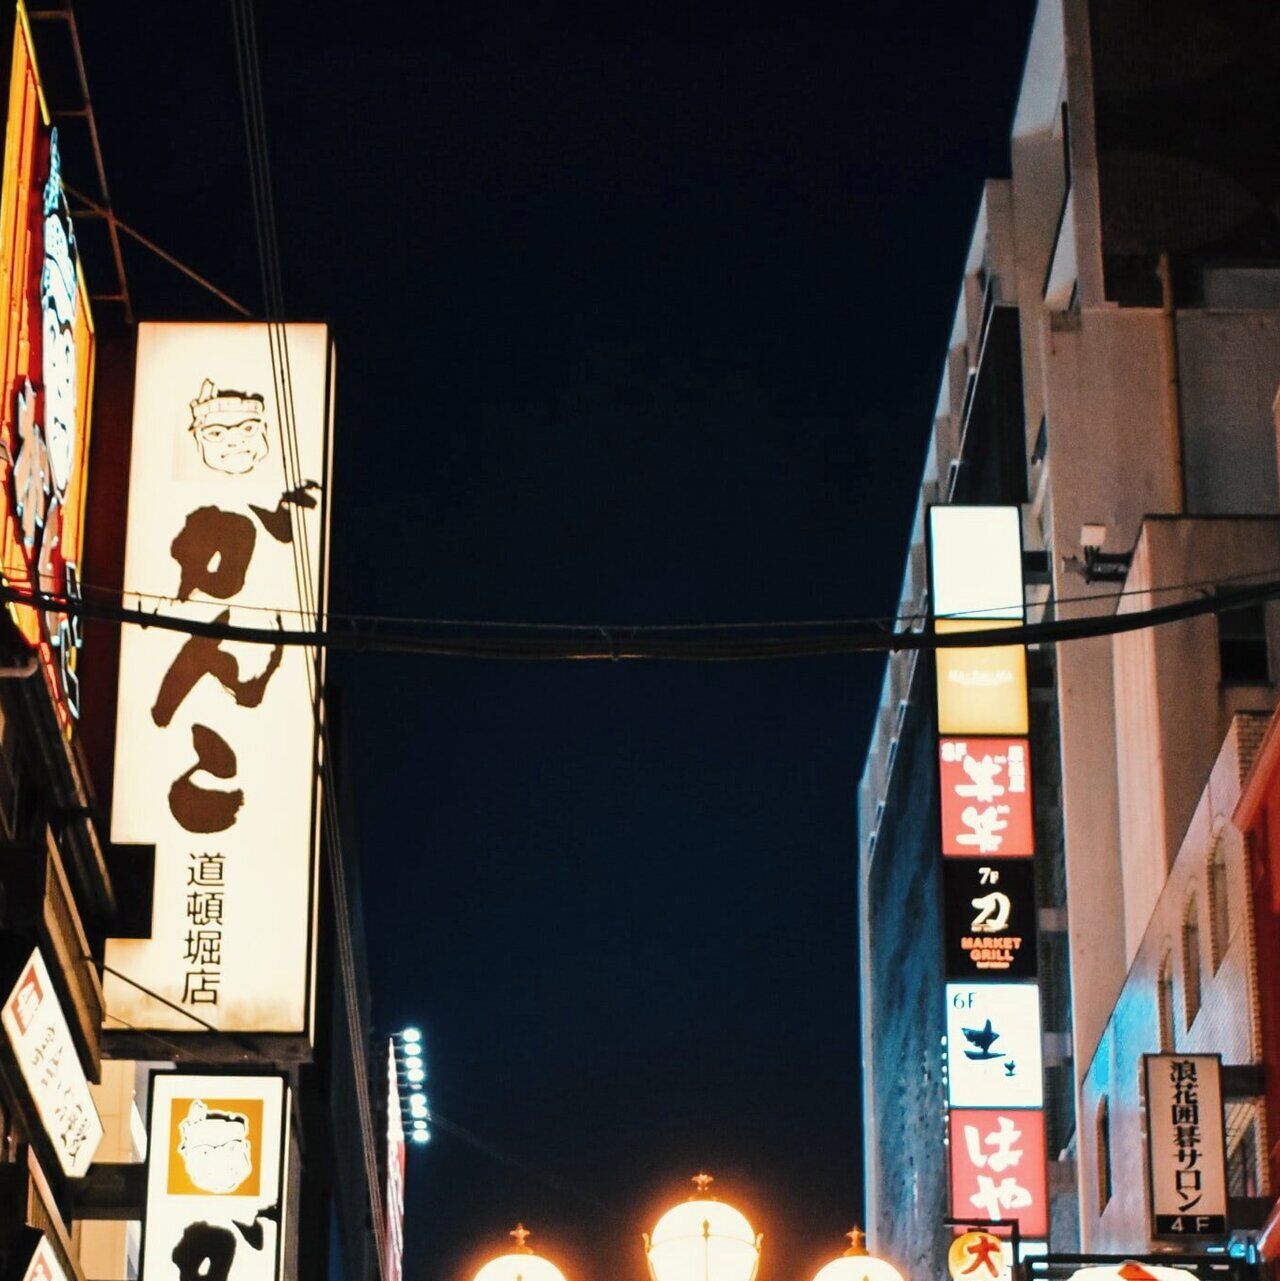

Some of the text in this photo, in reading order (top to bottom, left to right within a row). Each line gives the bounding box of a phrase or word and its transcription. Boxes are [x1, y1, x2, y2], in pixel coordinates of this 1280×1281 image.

[151, 479, 322, 834] がんこ
[181, 852, 226, 1006] 道頓堀店
[961, 937, 1021, 950] MARKET
[970, 950, 1014, 963] GRILL
[1169, 1060, 1203, 1212] 浪花囲碁サロン
